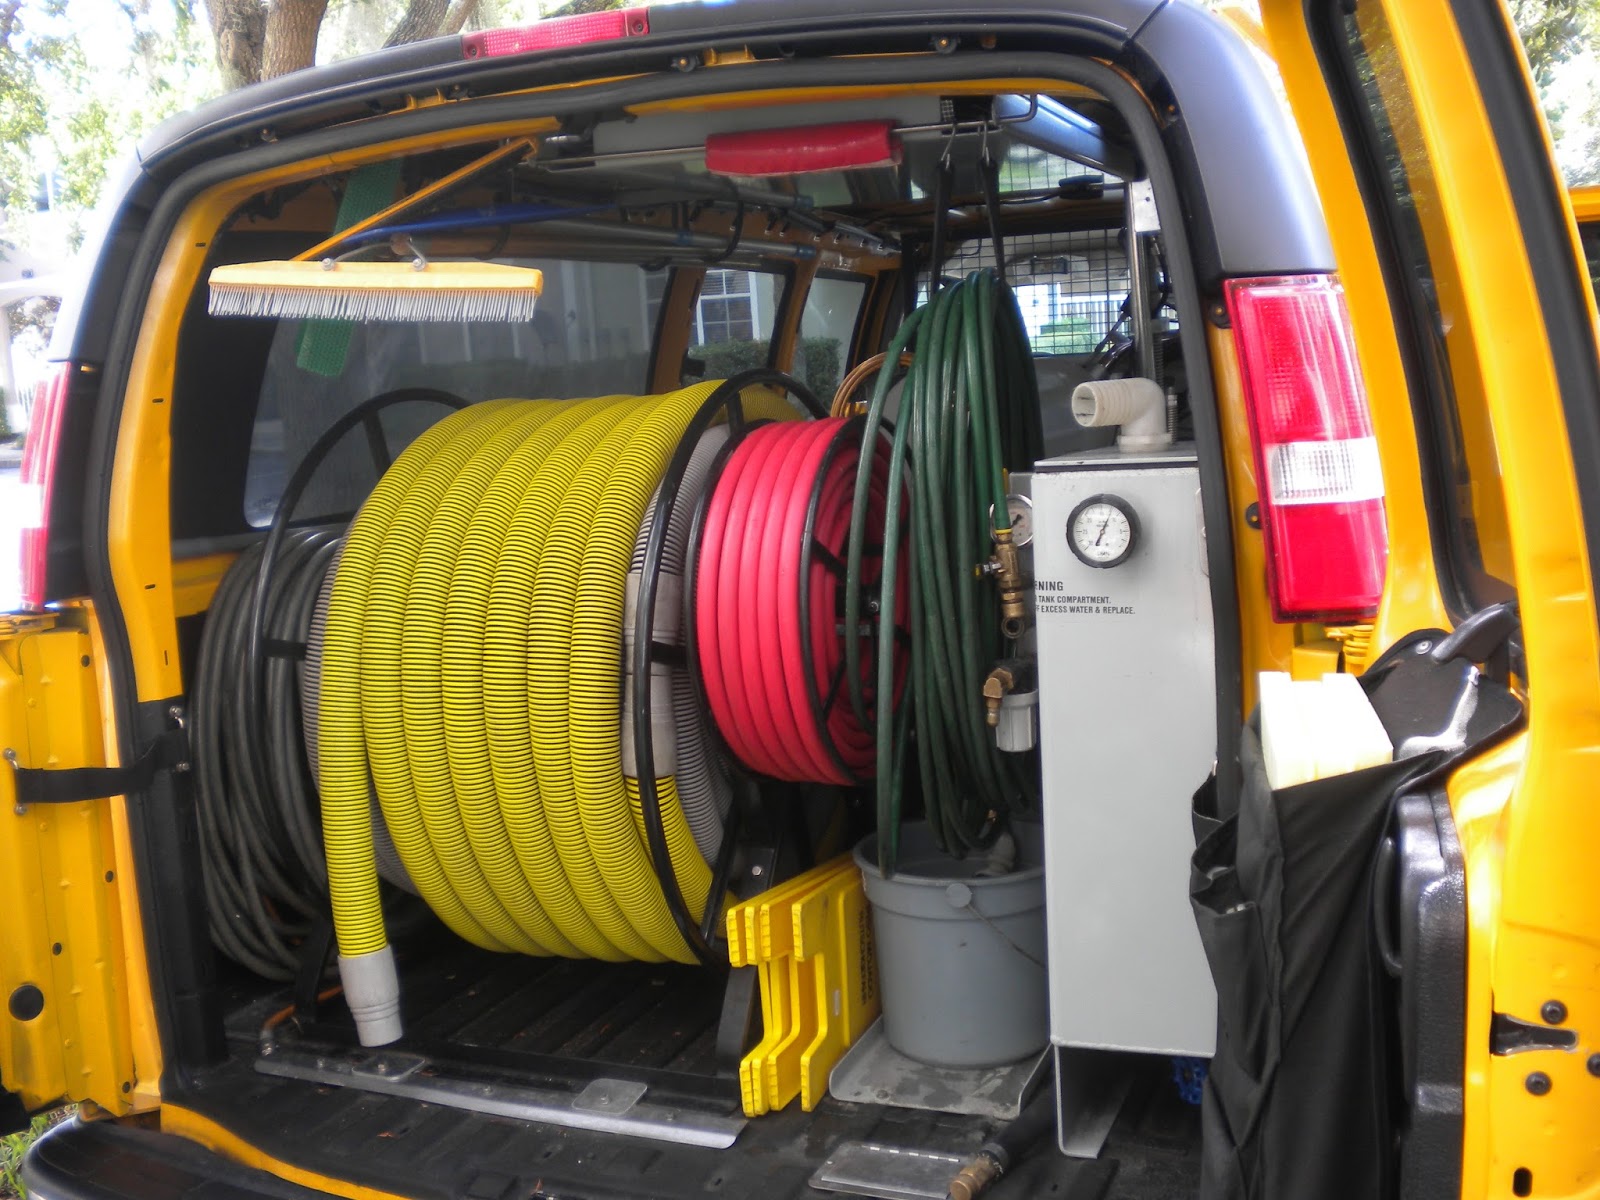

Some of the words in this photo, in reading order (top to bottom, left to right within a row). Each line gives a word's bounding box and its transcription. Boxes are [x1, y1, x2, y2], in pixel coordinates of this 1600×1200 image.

[1038, 595, 1055, 604] TANK
[1056, 595, 1112, 604] COMPARTMENT.
[1041, 605, 1068, 613] EXCESS
[1069, 606, 1094, 614] WATER
[1095, 606, 1101, 614] &
[1102, 606, 1136, 615] REPLACE.
